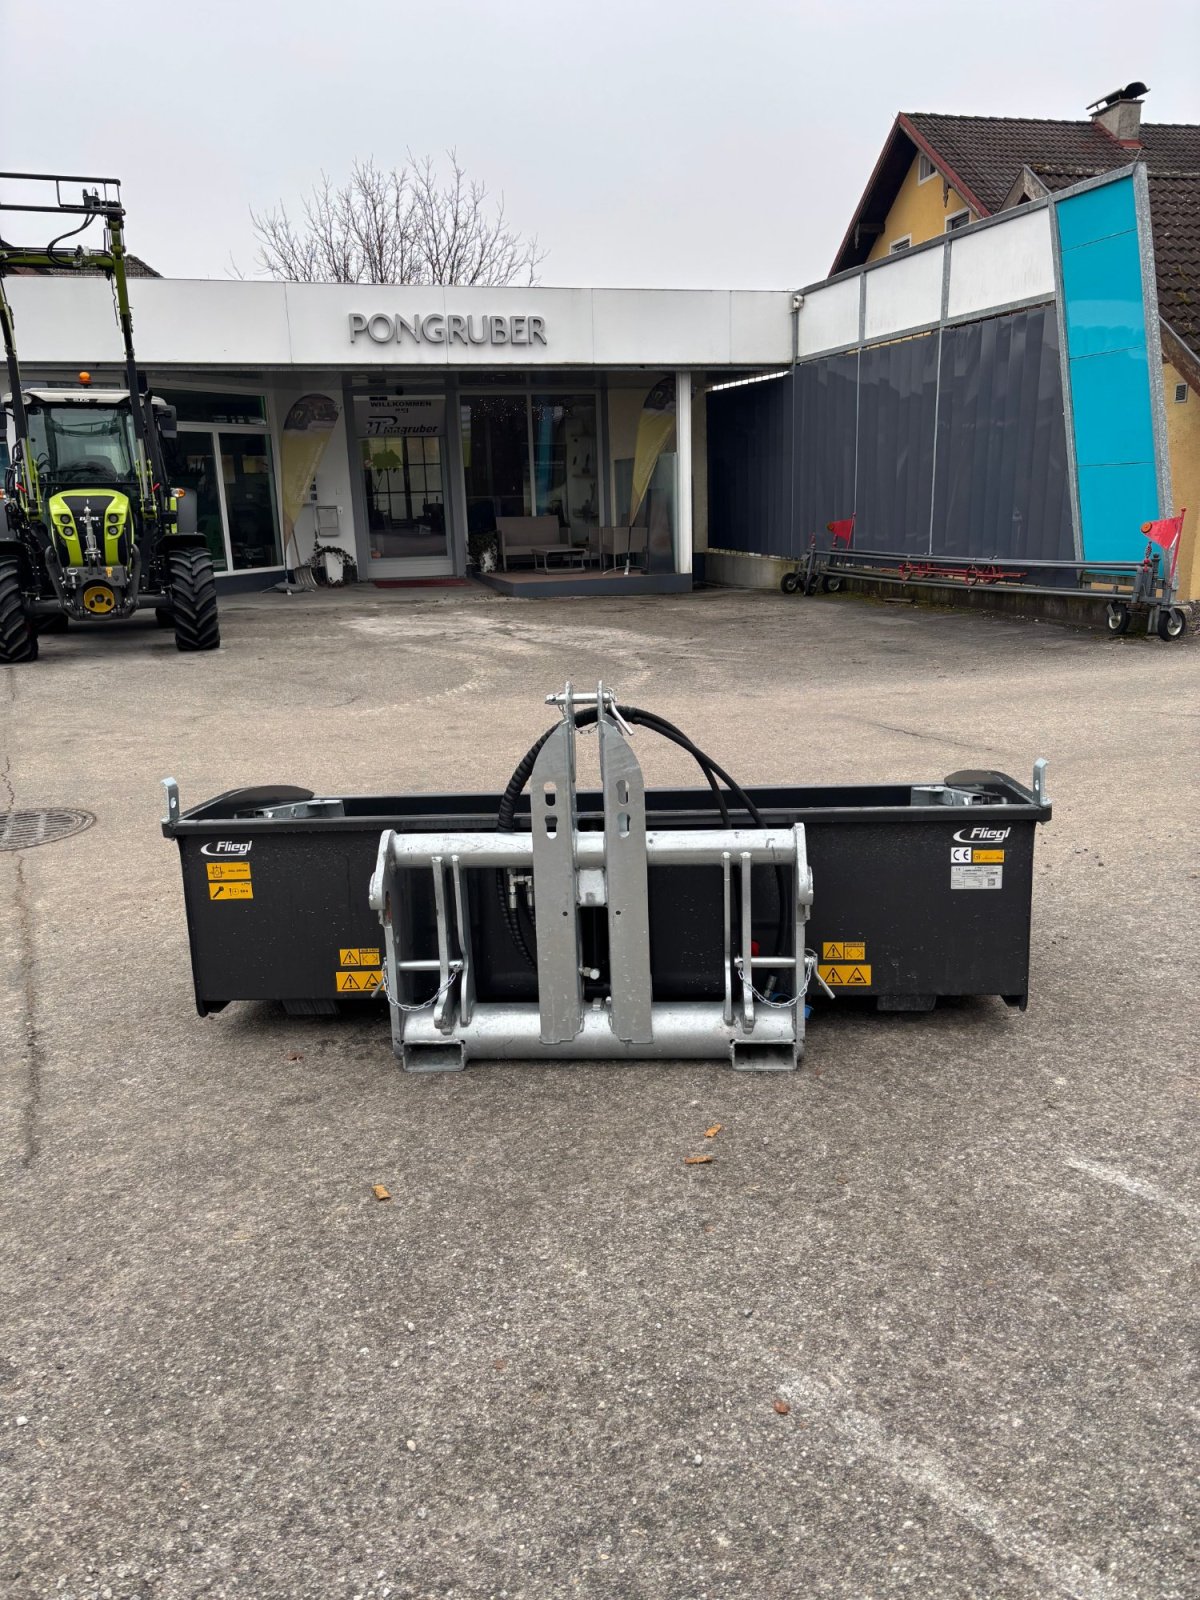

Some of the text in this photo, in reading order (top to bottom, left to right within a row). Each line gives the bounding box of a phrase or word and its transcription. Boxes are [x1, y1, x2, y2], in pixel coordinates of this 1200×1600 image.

[349, 313, 547, 345] PONGRUBER
[370, 400, 432, 408] WILLKOMMEN
[970, 826, 1012, 841] Fliegl
[216, 840, 253, 854] Fliegl
[953, 849, 970, 861] CE
